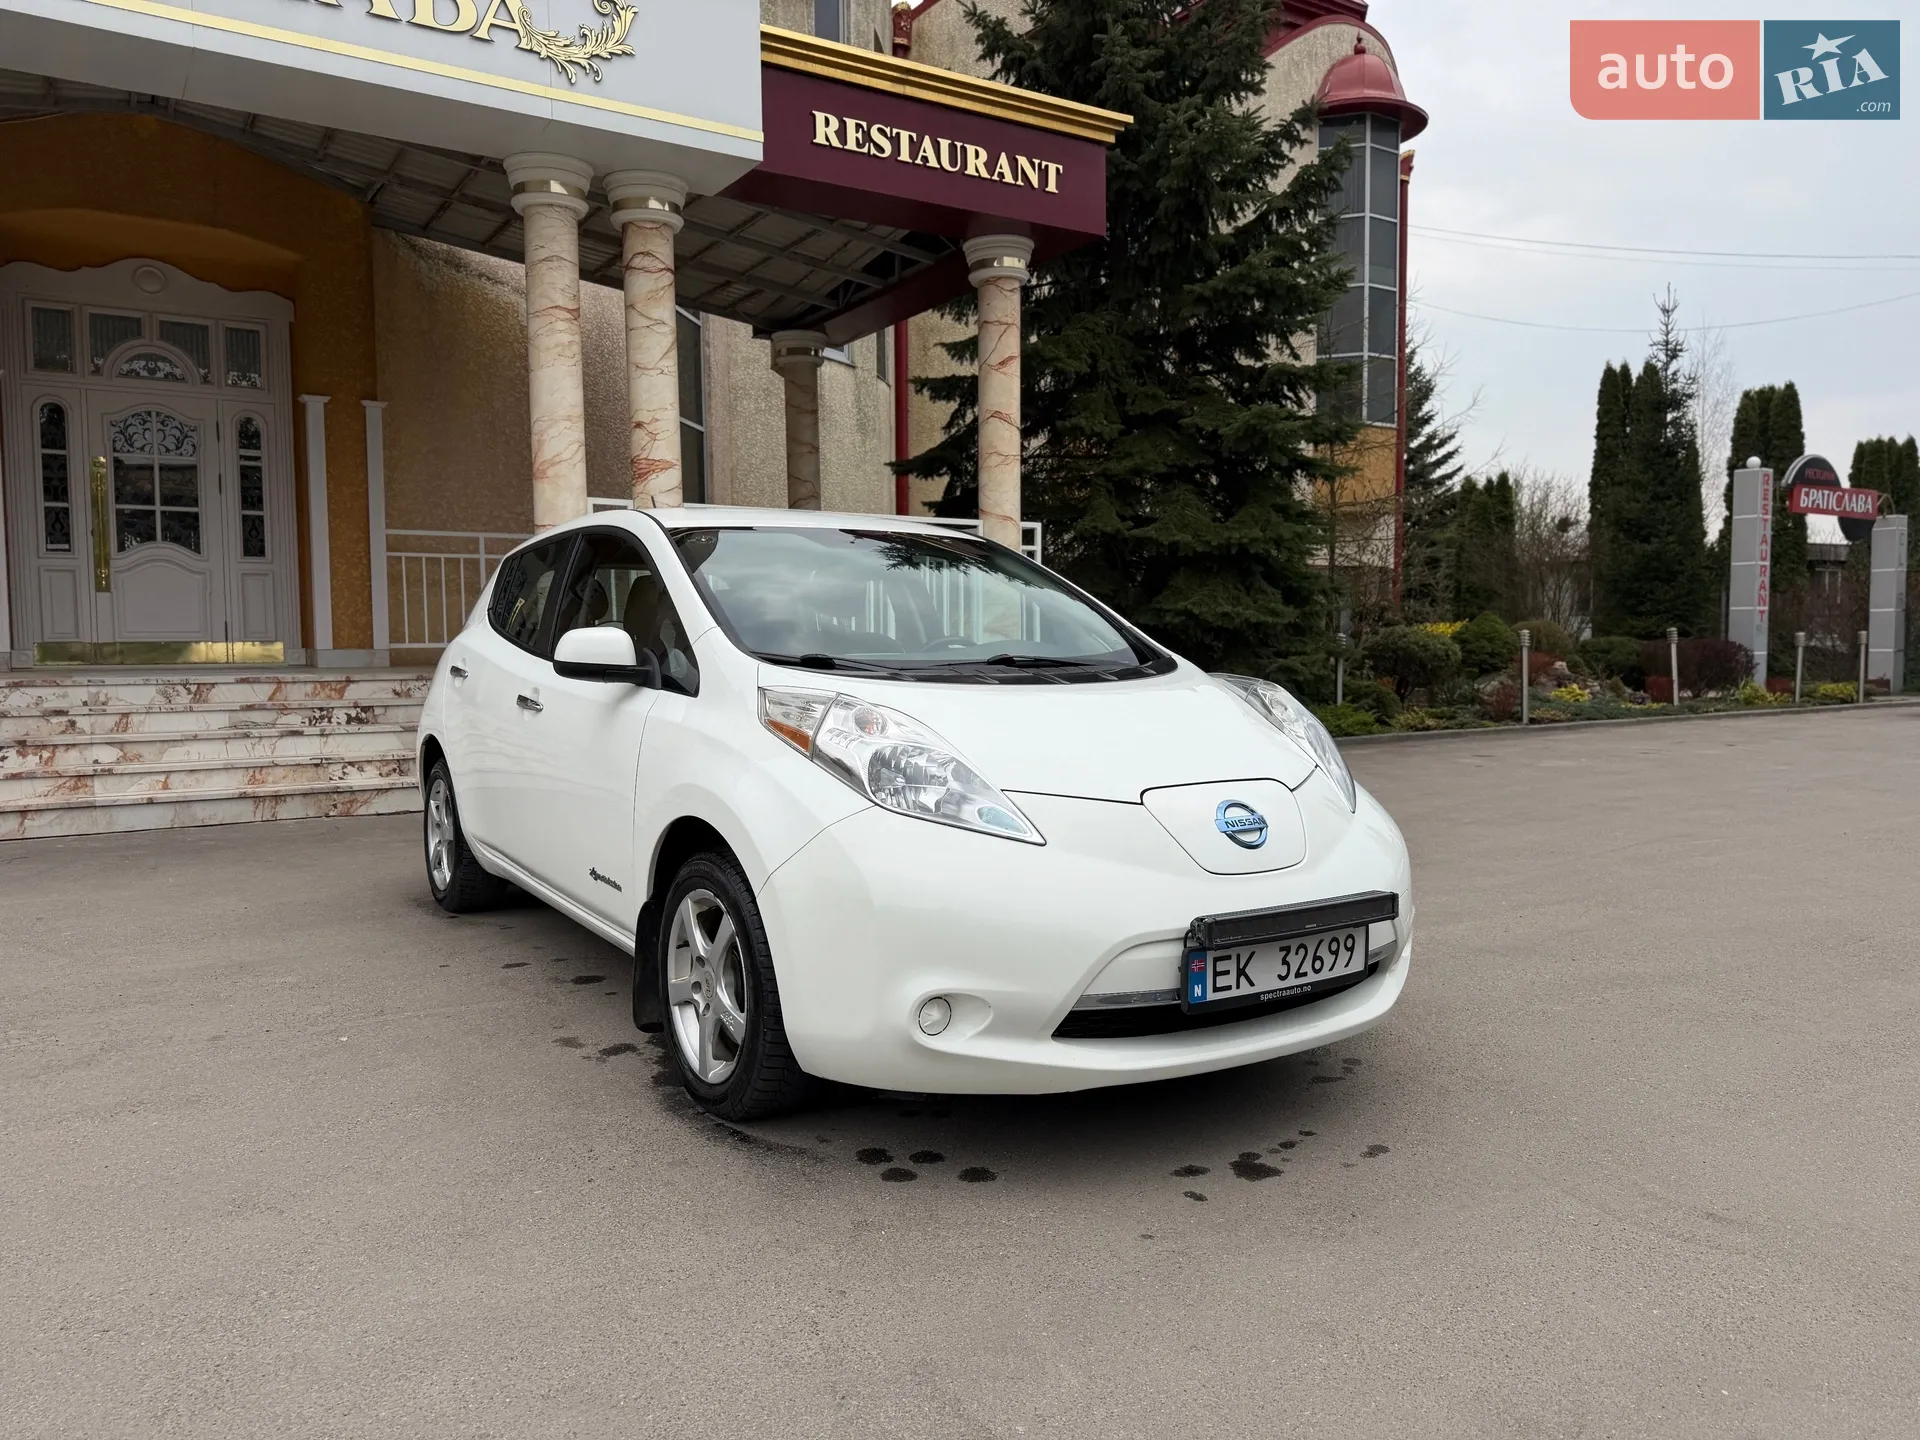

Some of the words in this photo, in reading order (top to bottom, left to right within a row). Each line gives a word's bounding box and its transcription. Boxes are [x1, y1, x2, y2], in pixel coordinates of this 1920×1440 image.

[812, 110, 1063, 194] RESTAURANT
[1800, 487, 1872, 513] БРАТІСЛАВА
[1756, 473, 1770, 622] RESTAURANT
[1224, 817, 1265, 828] NISSAN
[1212, 951, 1256, 993] EK
[1277, 934, 1356, 981] 32699
[1194, 984, 1202, 997] N
[1260, 984, 1312, 1001] spectraauto.no
